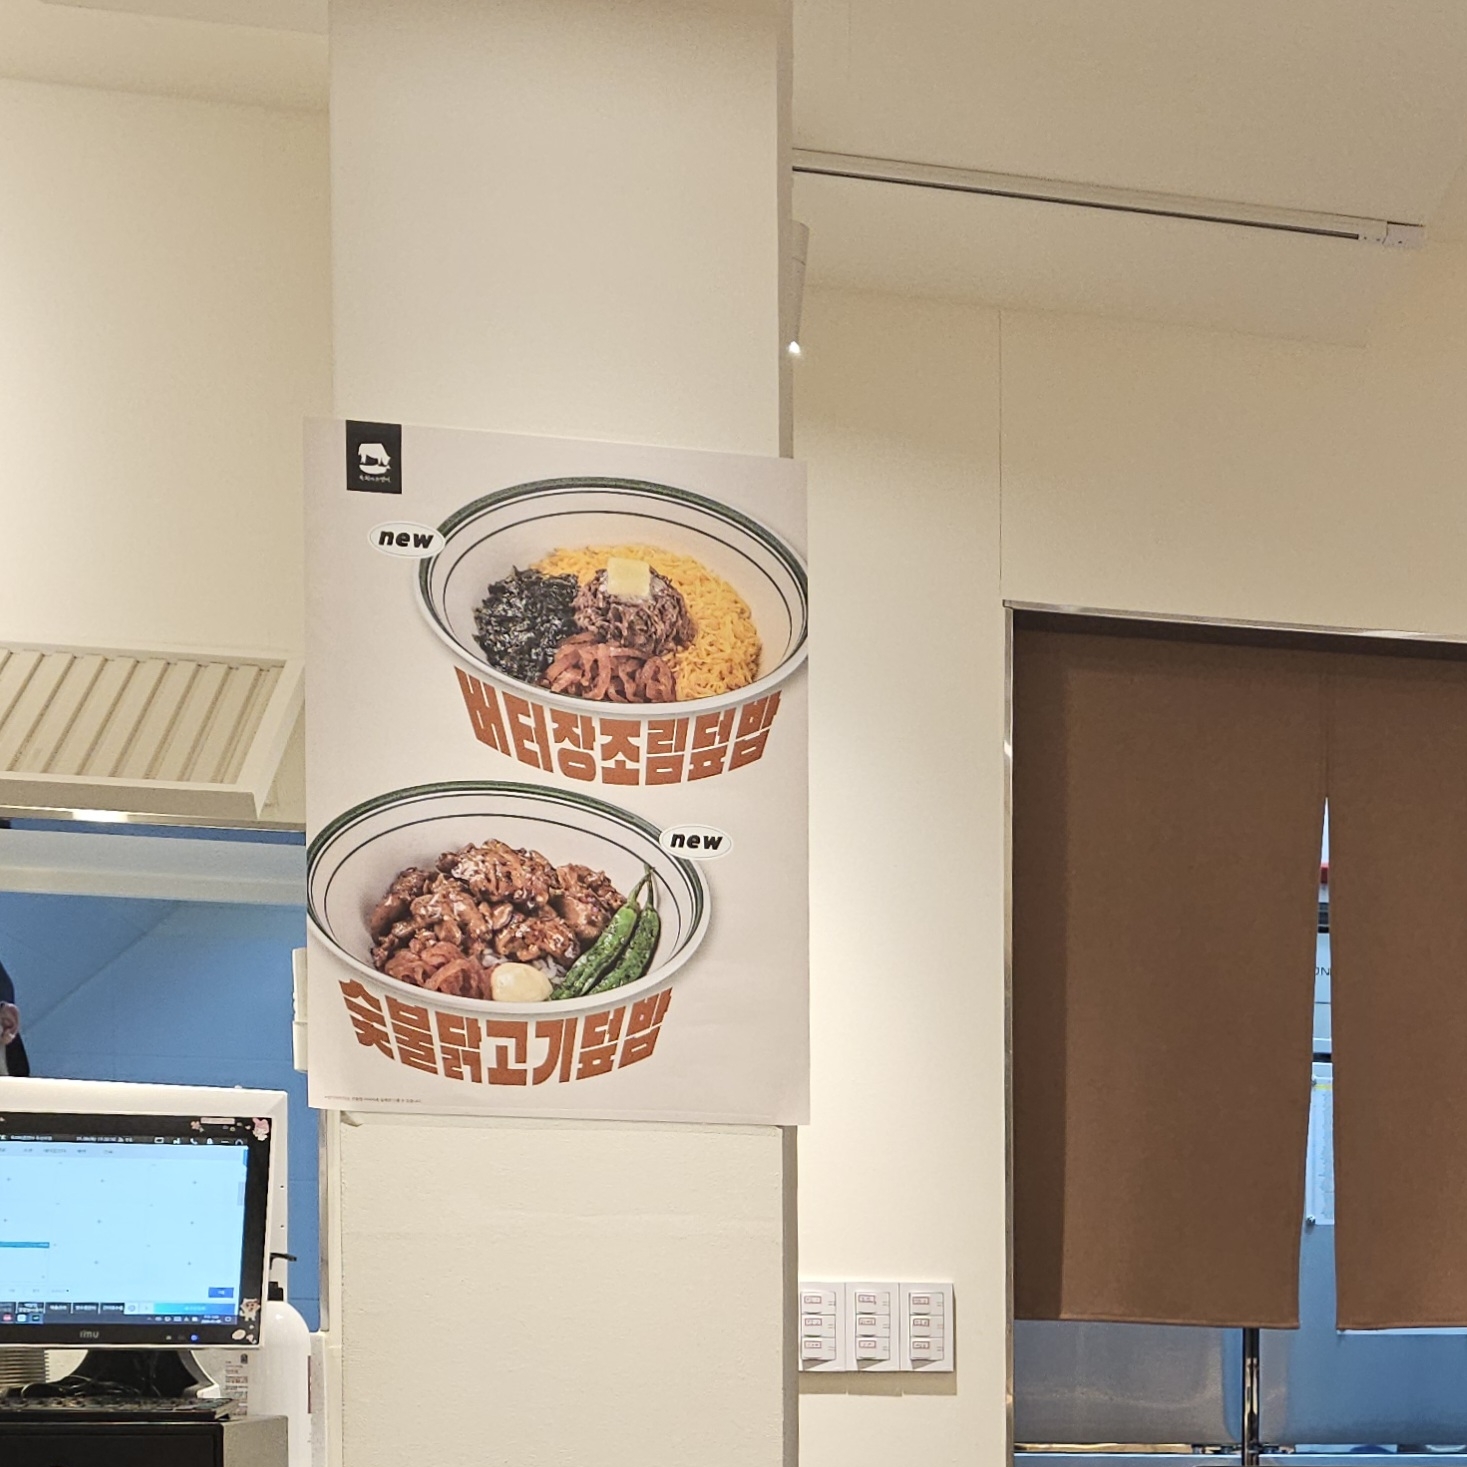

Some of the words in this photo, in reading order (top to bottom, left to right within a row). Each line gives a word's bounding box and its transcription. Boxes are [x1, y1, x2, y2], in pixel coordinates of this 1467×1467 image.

[378, 529, 434, 550] new
[454, 665, 782, 786] 버터장조림덮밥
[669, 832, 724, 851] new
[338, 979, 673, 1086] 숯불닭고기덮밥
